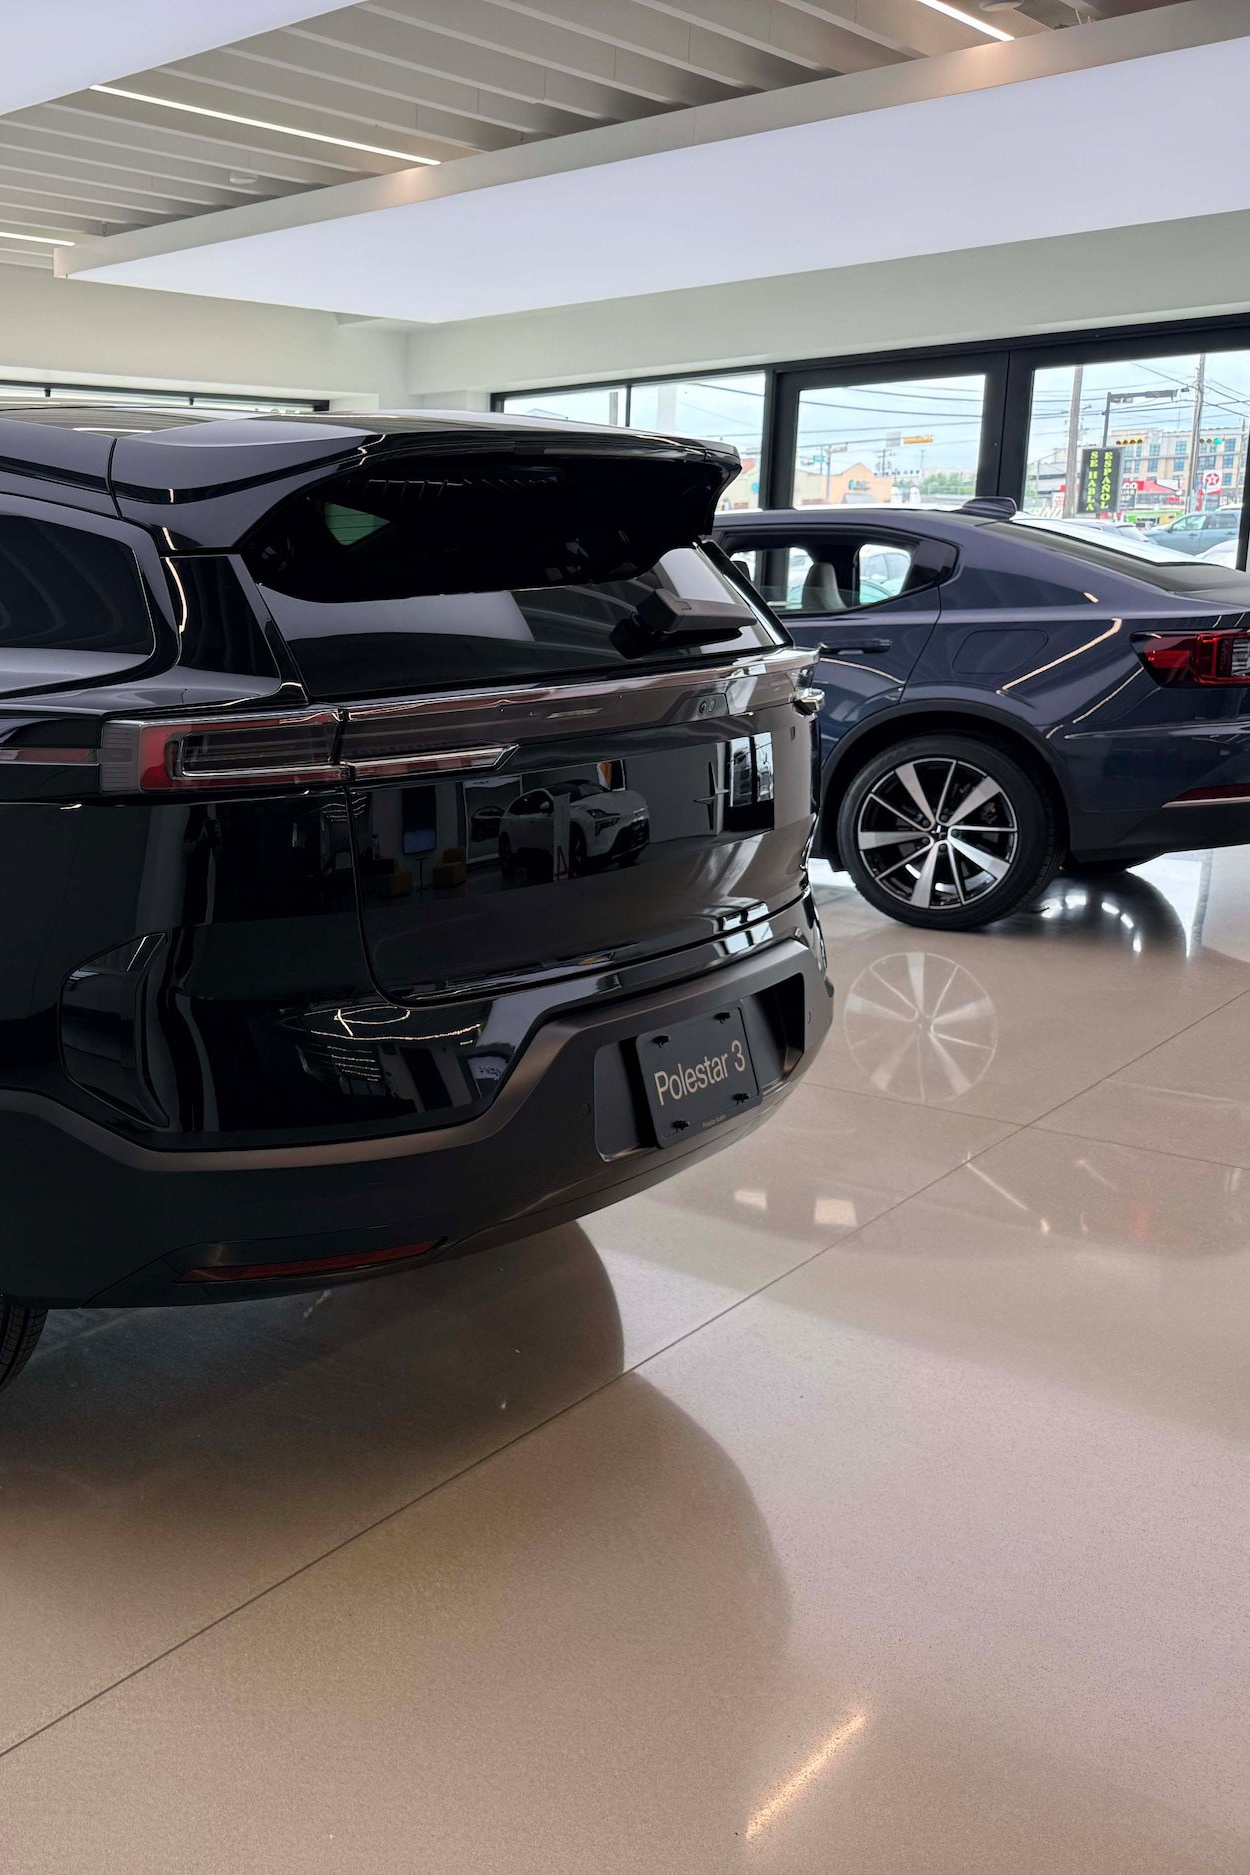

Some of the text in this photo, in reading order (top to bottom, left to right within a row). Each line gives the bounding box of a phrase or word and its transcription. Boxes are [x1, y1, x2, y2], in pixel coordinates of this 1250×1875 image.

[1085, 451, 1099, 511] SE HABLA
[654, 1040, 746, 1106] Polestar 3
